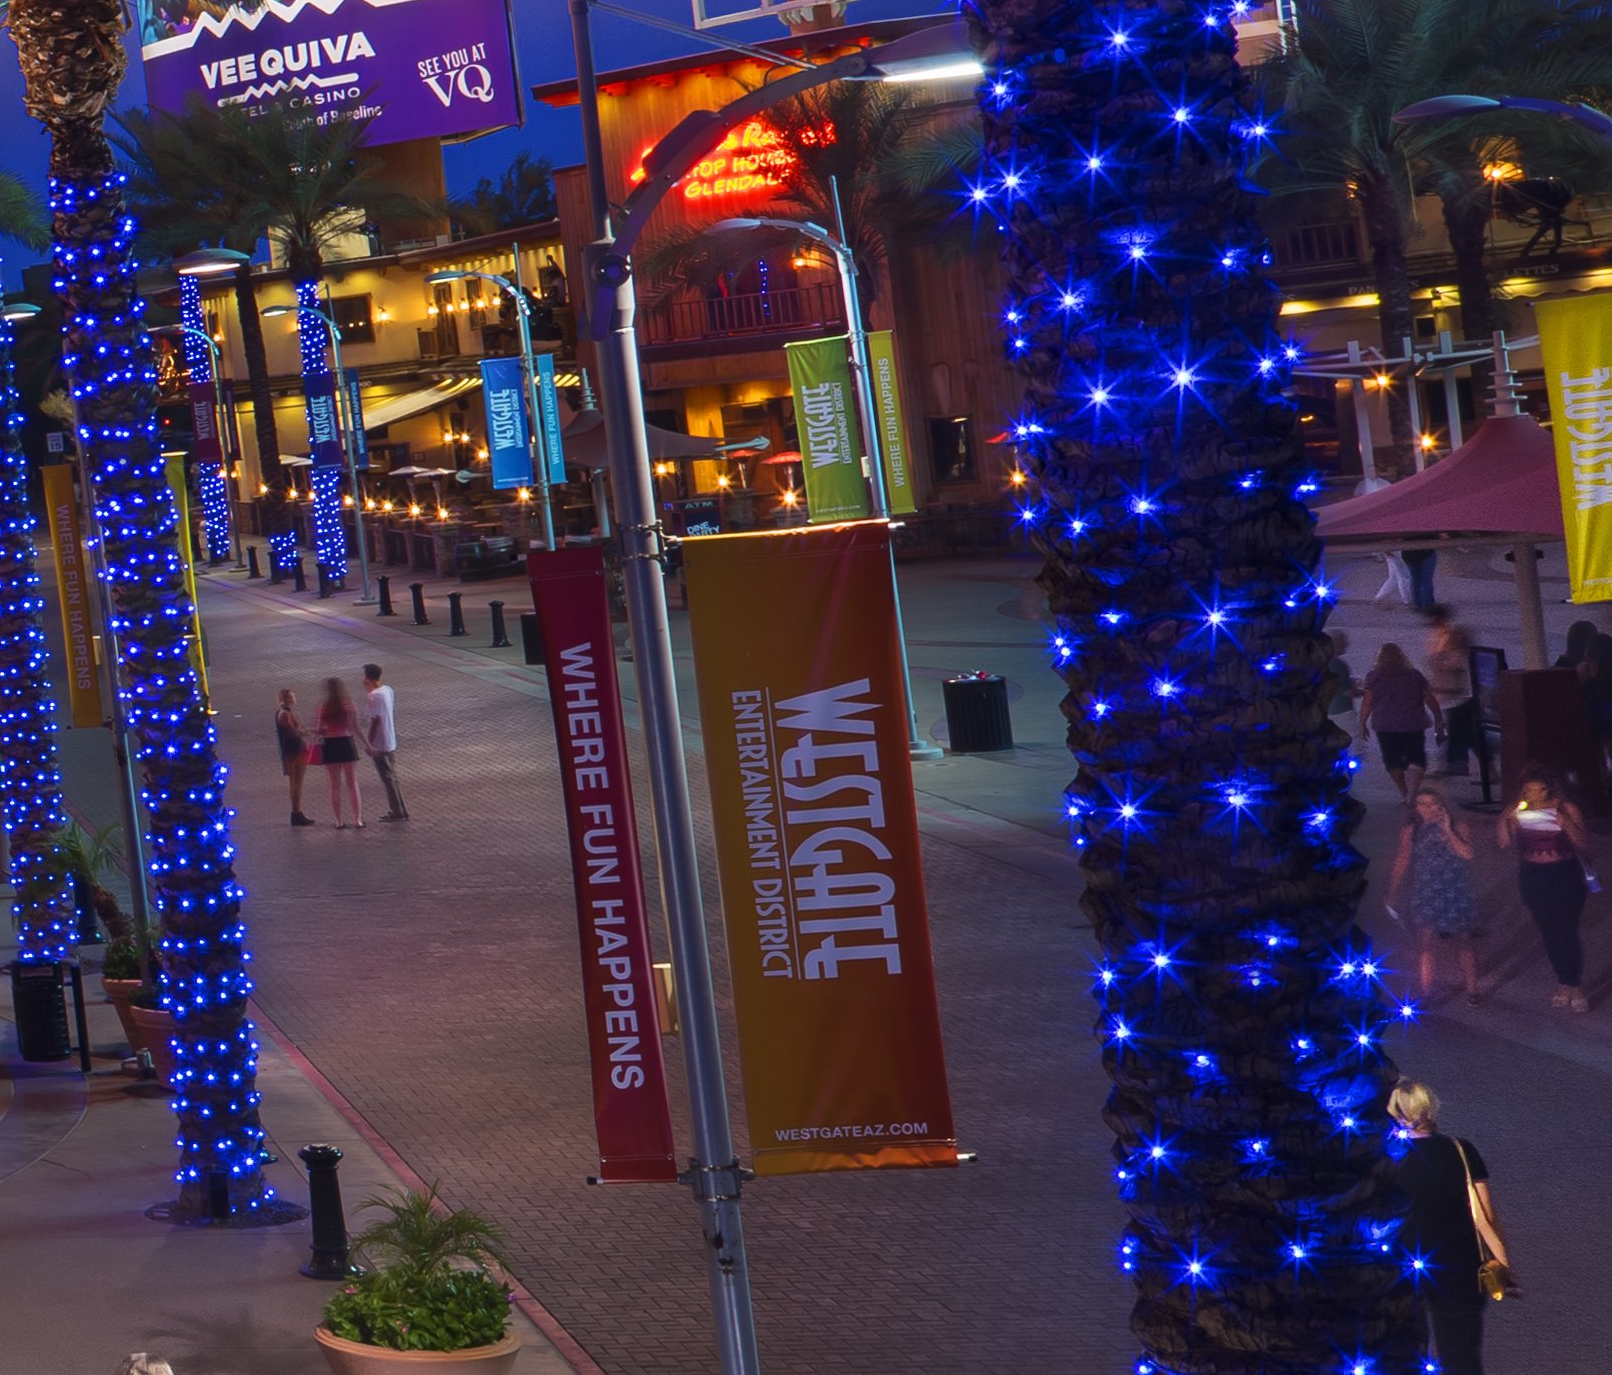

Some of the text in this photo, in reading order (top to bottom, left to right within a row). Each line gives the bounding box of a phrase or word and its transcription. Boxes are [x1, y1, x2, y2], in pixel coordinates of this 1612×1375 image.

[200, 31, 376, 89] VEE QUIVA
[418, 42, 486, 80] SEE YOU AT
[422, 63, 495, 109] VQ
[289, 87, 361, 109] CASINO
[316, 111, 328, 127] of
[310, 395, 329, 444] WESTGATE
[350, 382, 365, 454] WHERE FUN HAPPENS
[490, 389, 515, 451] WESTGATE
[541, 371, 560, 465] WHERE FUN HAPPENS
[801, 382, 840, 468] WESTGATE
[832, 382, 852, 464] ENTERTAINMENT DISTRICT
[878, 358, 905, 487] WHERE FUN HAPPENS
[685, 501, 713, 510] ATM
[55, 504, 92, 690] WHERE FUN HAPPENS
[731, 689, 794, 981] ENTERTAINMENT DISTRICT
[774, 677, 903, 981] WESTGATE
[559, 640, 646, 1091] WHERE FUN HAPPENS
[774, 1121, 929, 1142] WESTGATEAZ.COM
